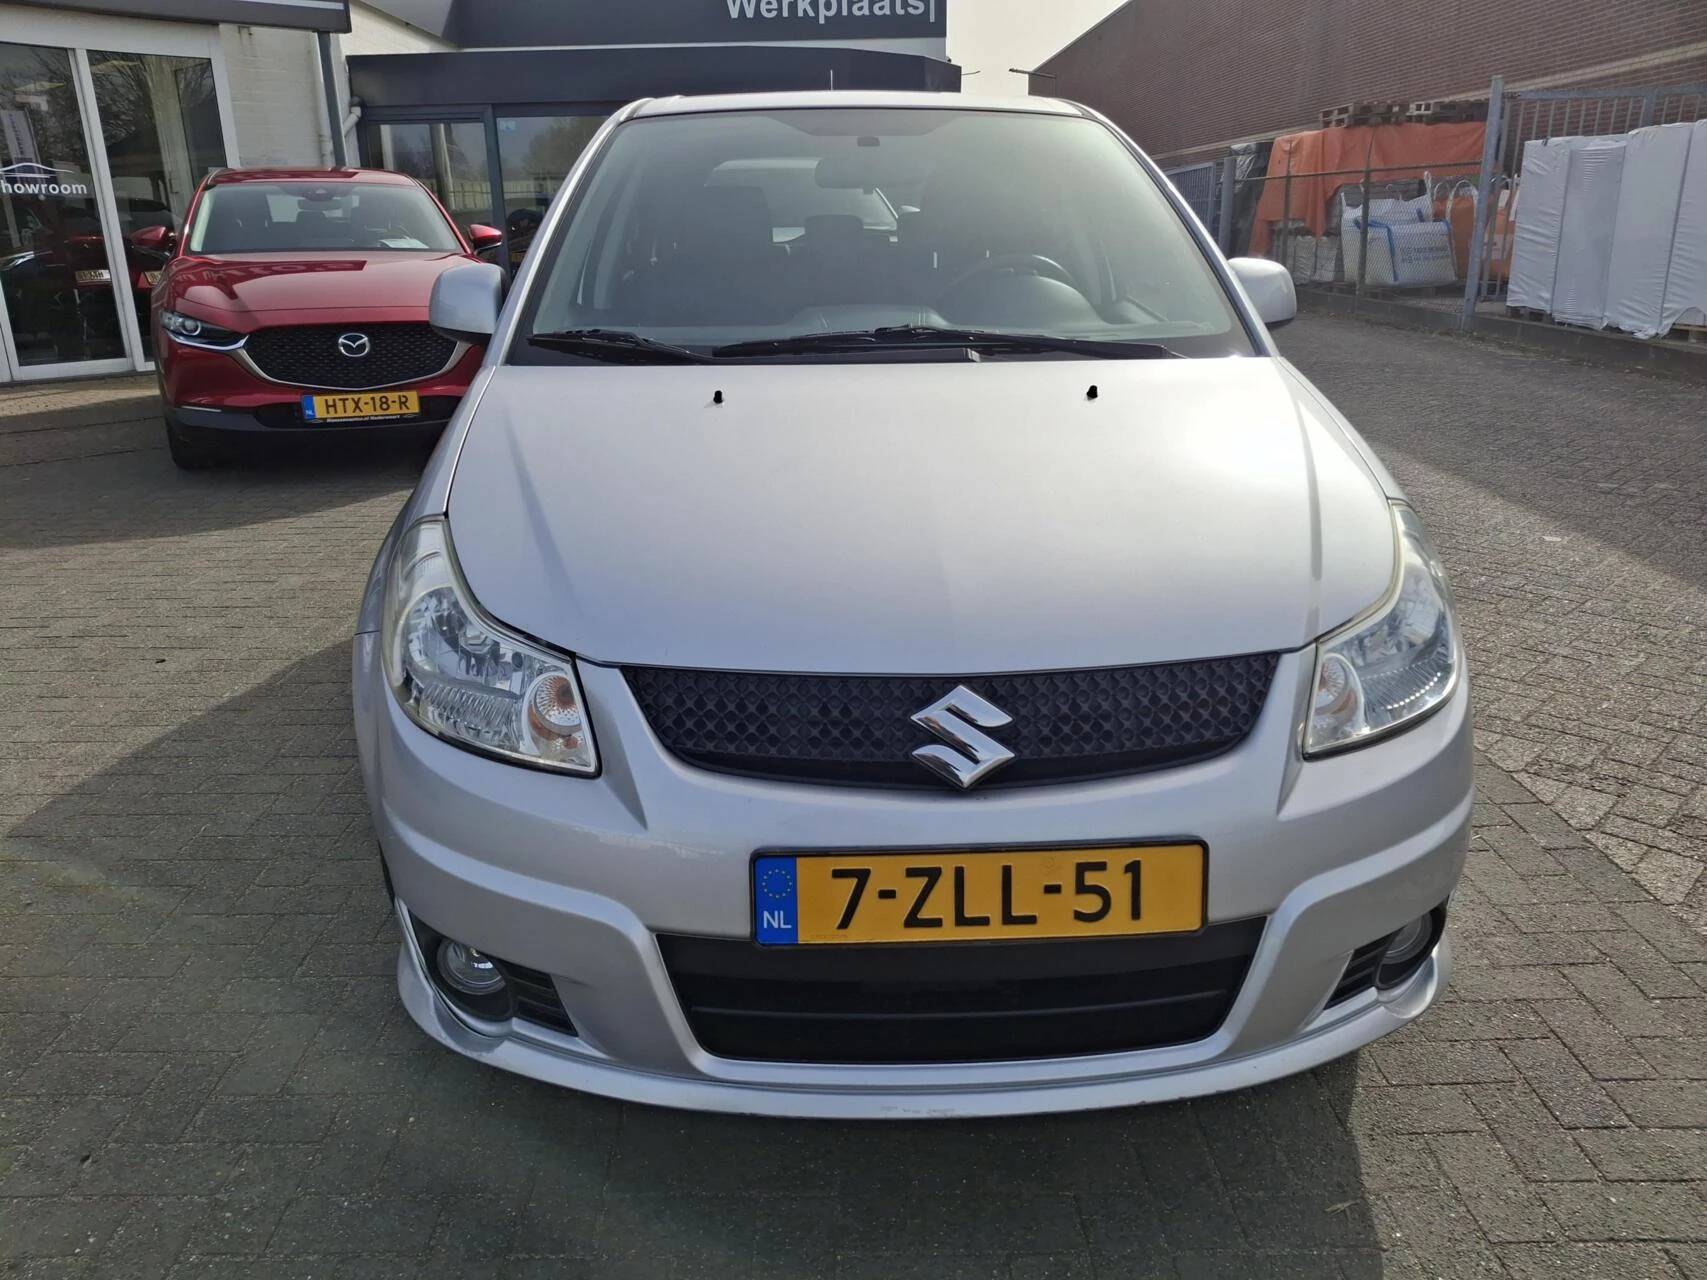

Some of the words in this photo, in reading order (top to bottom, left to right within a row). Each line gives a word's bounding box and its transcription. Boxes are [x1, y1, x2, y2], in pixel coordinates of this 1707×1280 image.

[325, 395, 410, 414] HTX-18-R
[831, 859, 1142, 930] 7-ZLL-51
[763, 911, 793, 929] NL
